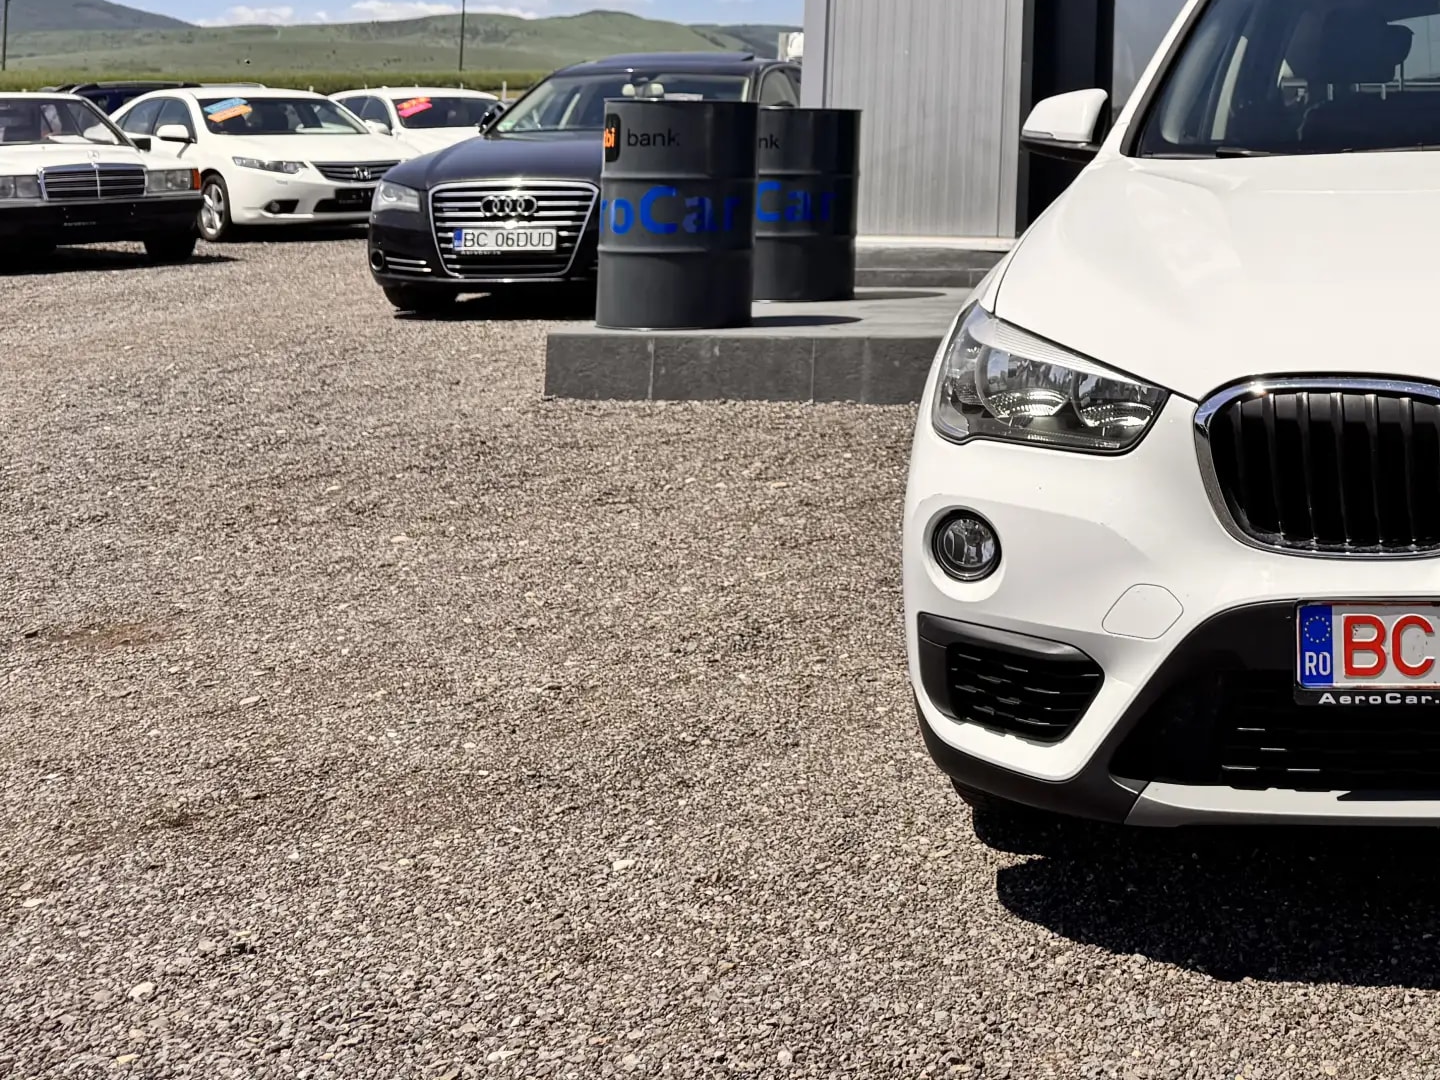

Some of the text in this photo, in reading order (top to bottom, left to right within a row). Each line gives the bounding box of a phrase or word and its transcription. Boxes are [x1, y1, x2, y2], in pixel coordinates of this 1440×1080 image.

[603, 127, 680, 148] bi bank
[758, 133, 780, 149] nk
[601, 185, 741, 235] roCar
[755, 180, 838, 222] Car
[464, 232, 488, 247] BC
[1304, 651, 1331, 676] RO
[1342, 614, 1435, 677] BC
